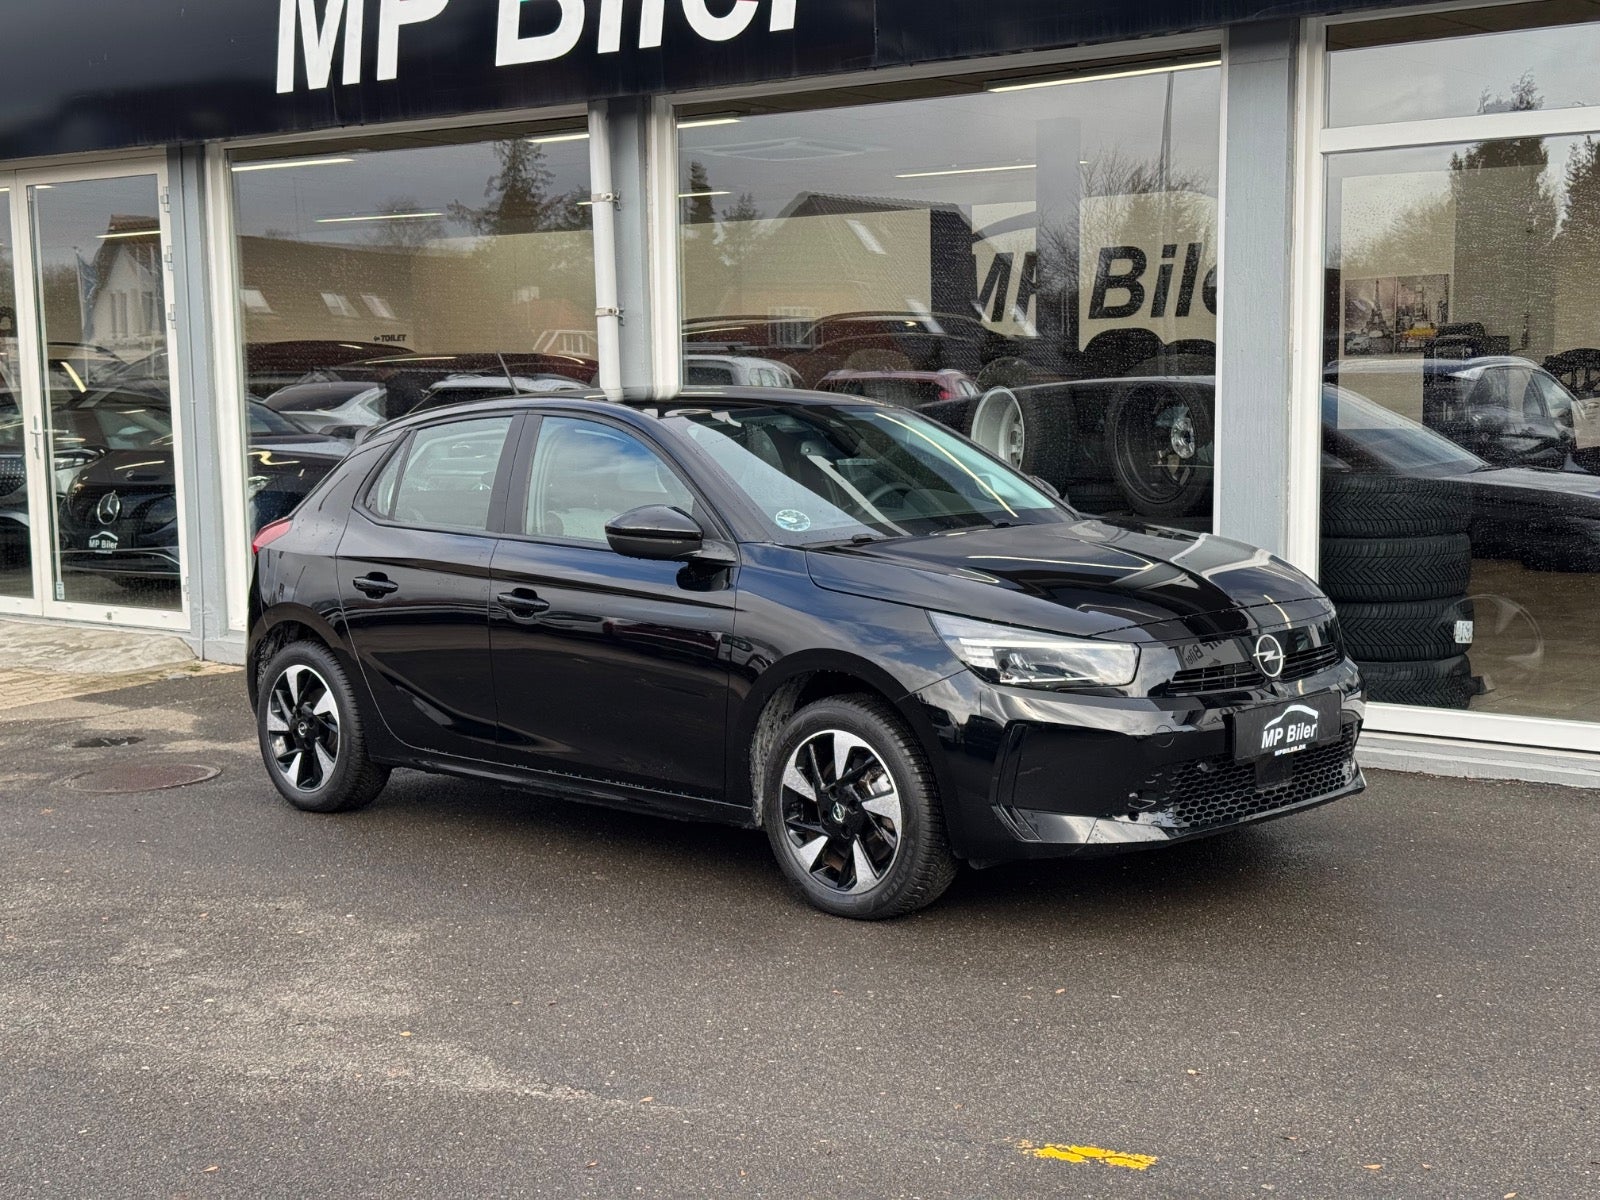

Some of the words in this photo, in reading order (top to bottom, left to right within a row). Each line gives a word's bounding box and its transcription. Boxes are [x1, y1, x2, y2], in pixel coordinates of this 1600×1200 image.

[380, 334, 407, 342] TOILET
[1261, 728, 1284, 749] MP
[1286, 722, 1318, 743] Biler
